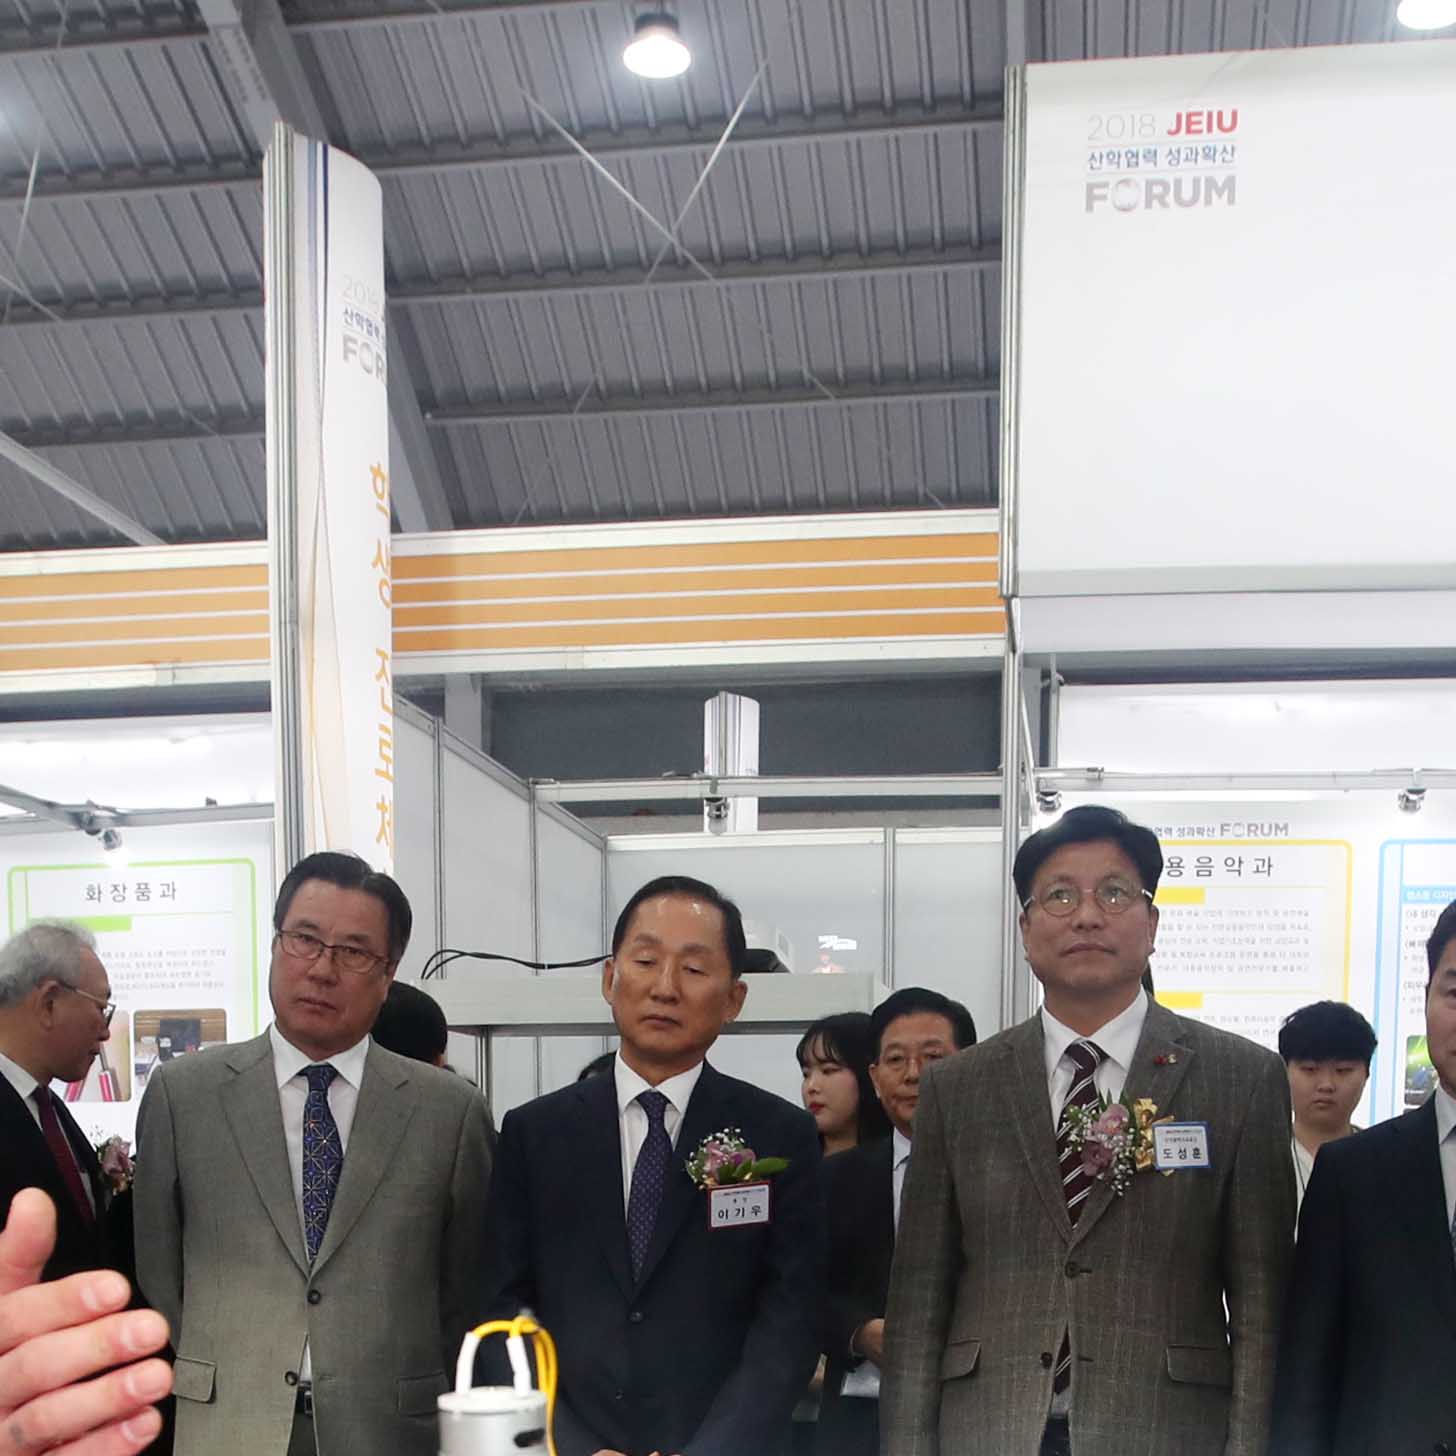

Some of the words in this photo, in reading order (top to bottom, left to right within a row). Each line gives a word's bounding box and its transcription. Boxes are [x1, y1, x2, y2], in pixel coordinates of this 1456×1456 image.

[1087, 112, 1156, 141] 2018
[1166, 108, 1239, 137] JEIU
[1087, 147, 1159, 171] 산학협력
[1165, 143, 1236, 167] 성과확산
[1085, 174, 1237, 214] FORUM
[342, 333, 386, 382] FOR
[1219, 822, 1290, 838] FORUM
[1165, 855, 1274, 879] 용음악과
[84, 880, 177, 904] 화장품과
